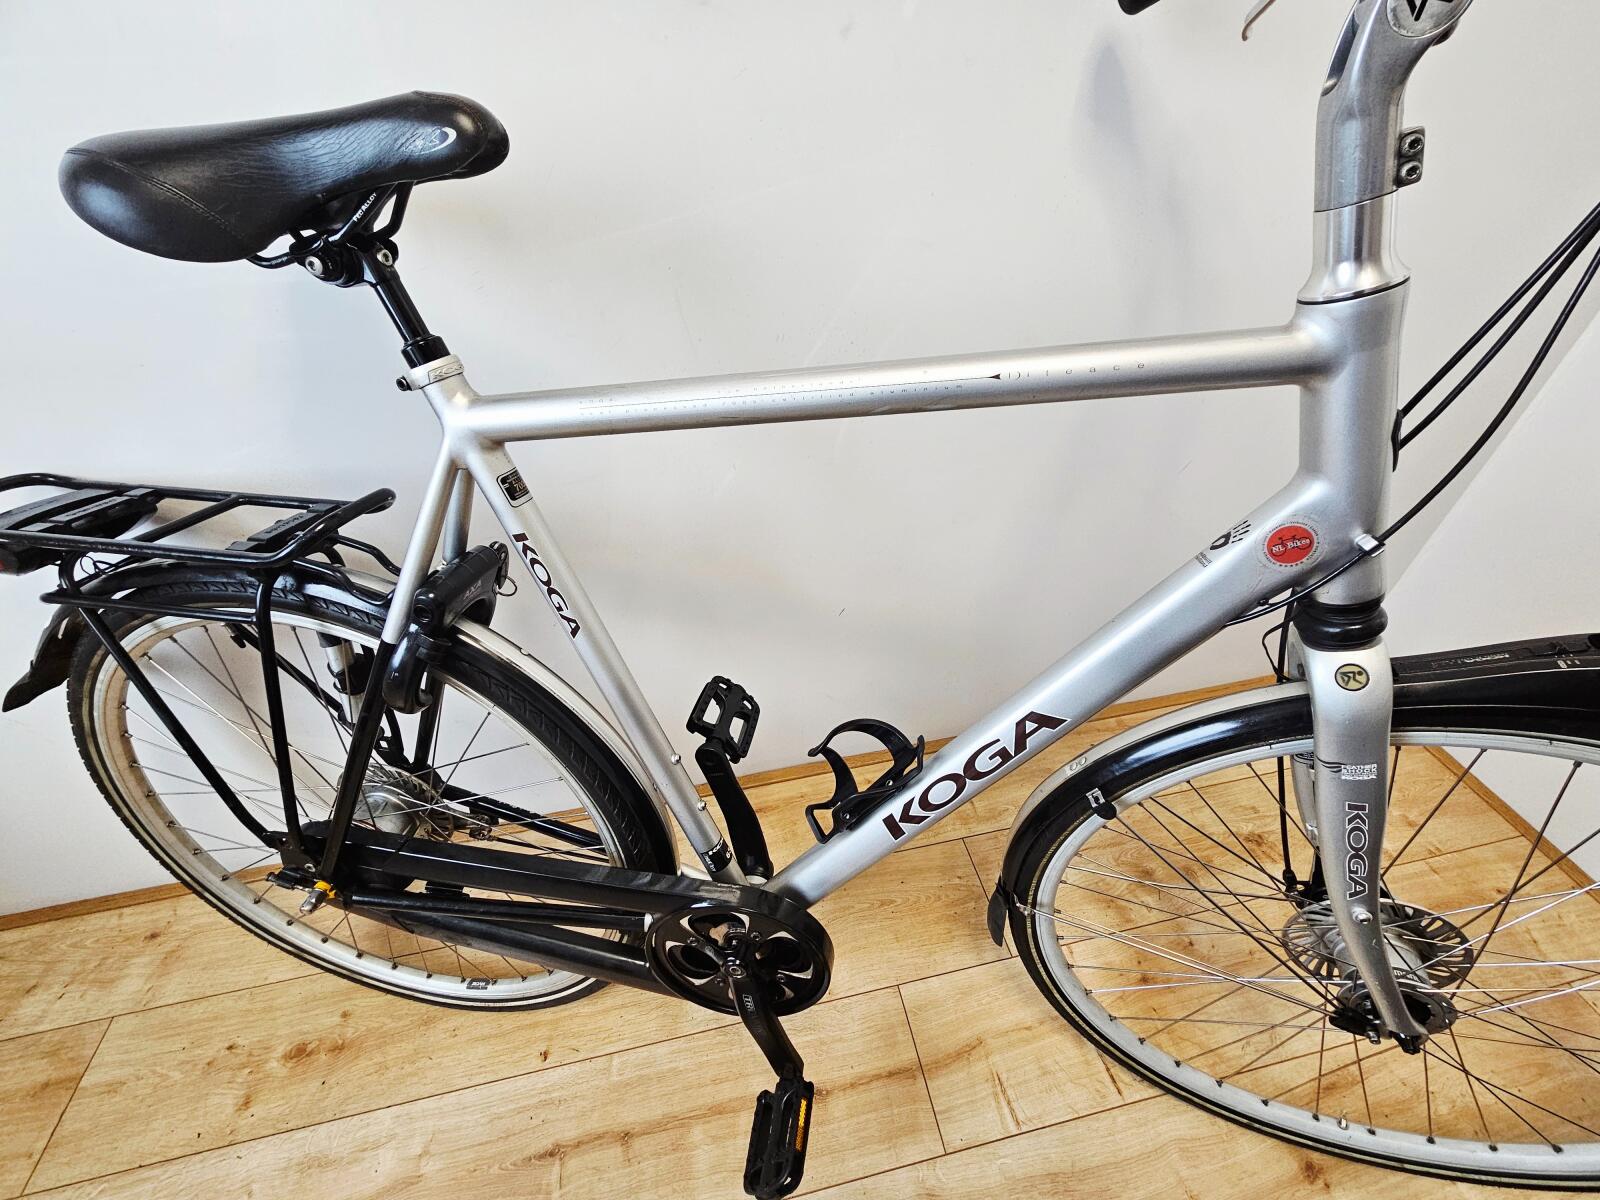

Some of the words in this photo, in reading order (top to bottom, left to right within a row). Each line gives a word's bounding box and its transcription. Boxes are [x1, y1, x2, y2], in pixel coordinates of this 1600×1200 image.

[361, 192, 377, 212] ALLOY
[512, 532, 581, 639] KOGA
[1285, 538, 1310, 550] Bikes
[882, 710, 1072, 841] KOGA
[1345, 801, 1369, 900] KOGA
